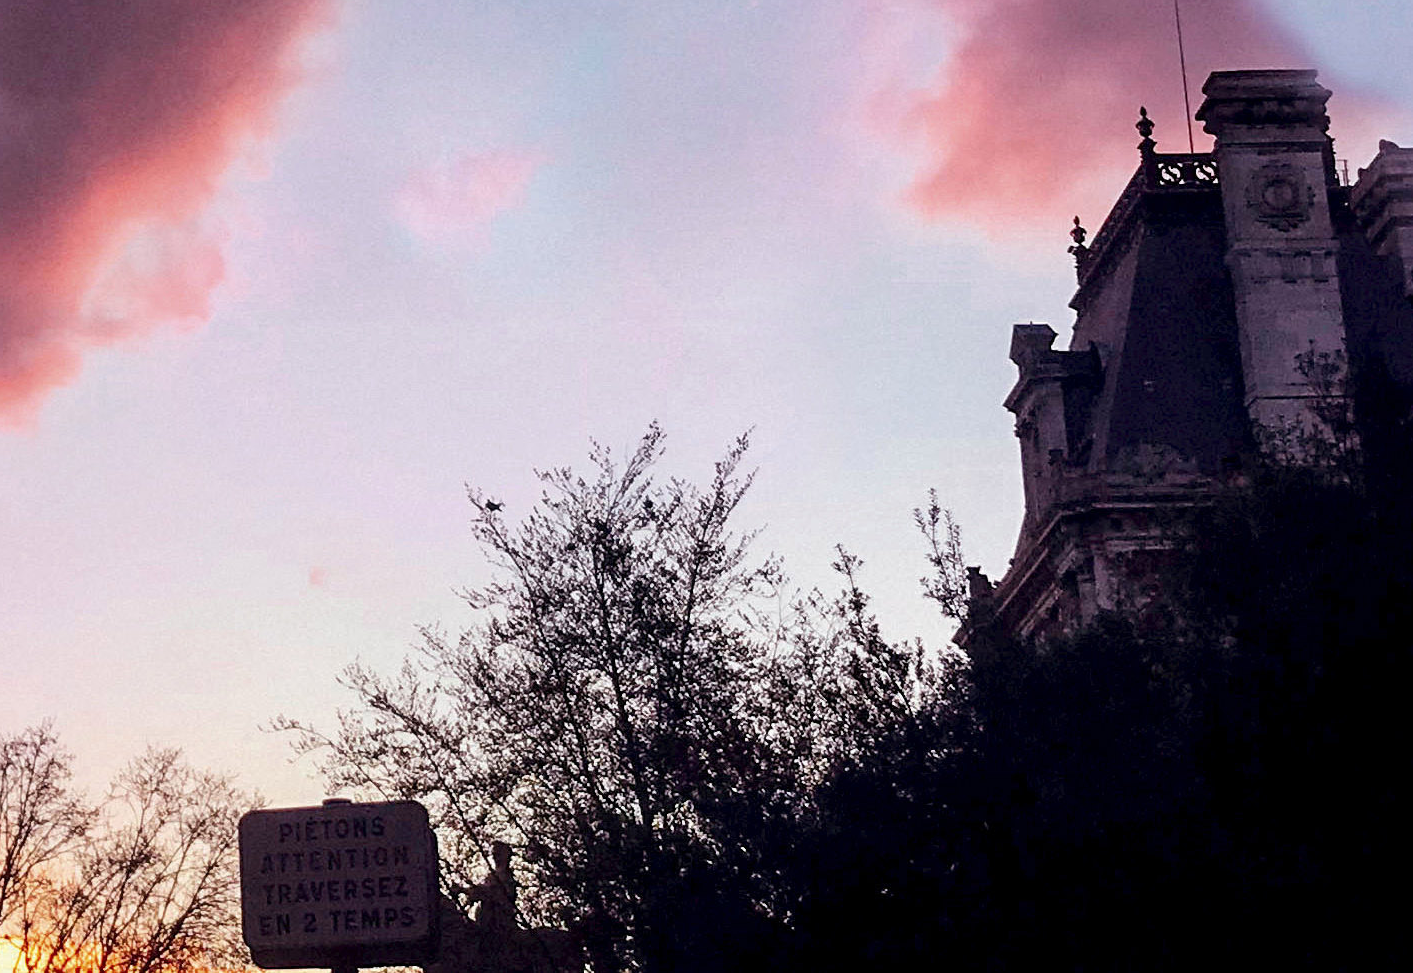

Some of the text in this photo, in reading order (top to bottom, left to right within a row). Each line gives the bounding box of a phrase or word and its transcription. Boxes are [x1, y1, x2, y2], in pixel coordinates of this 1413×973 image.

[279, 816, 385, 842] PIÉTONS
[261, 845, 409, 873] ATTENTION
[262, 876, 408, 905] TRAVERSEZ
[259, 906, 414, 936] EN 2 TEMPS
